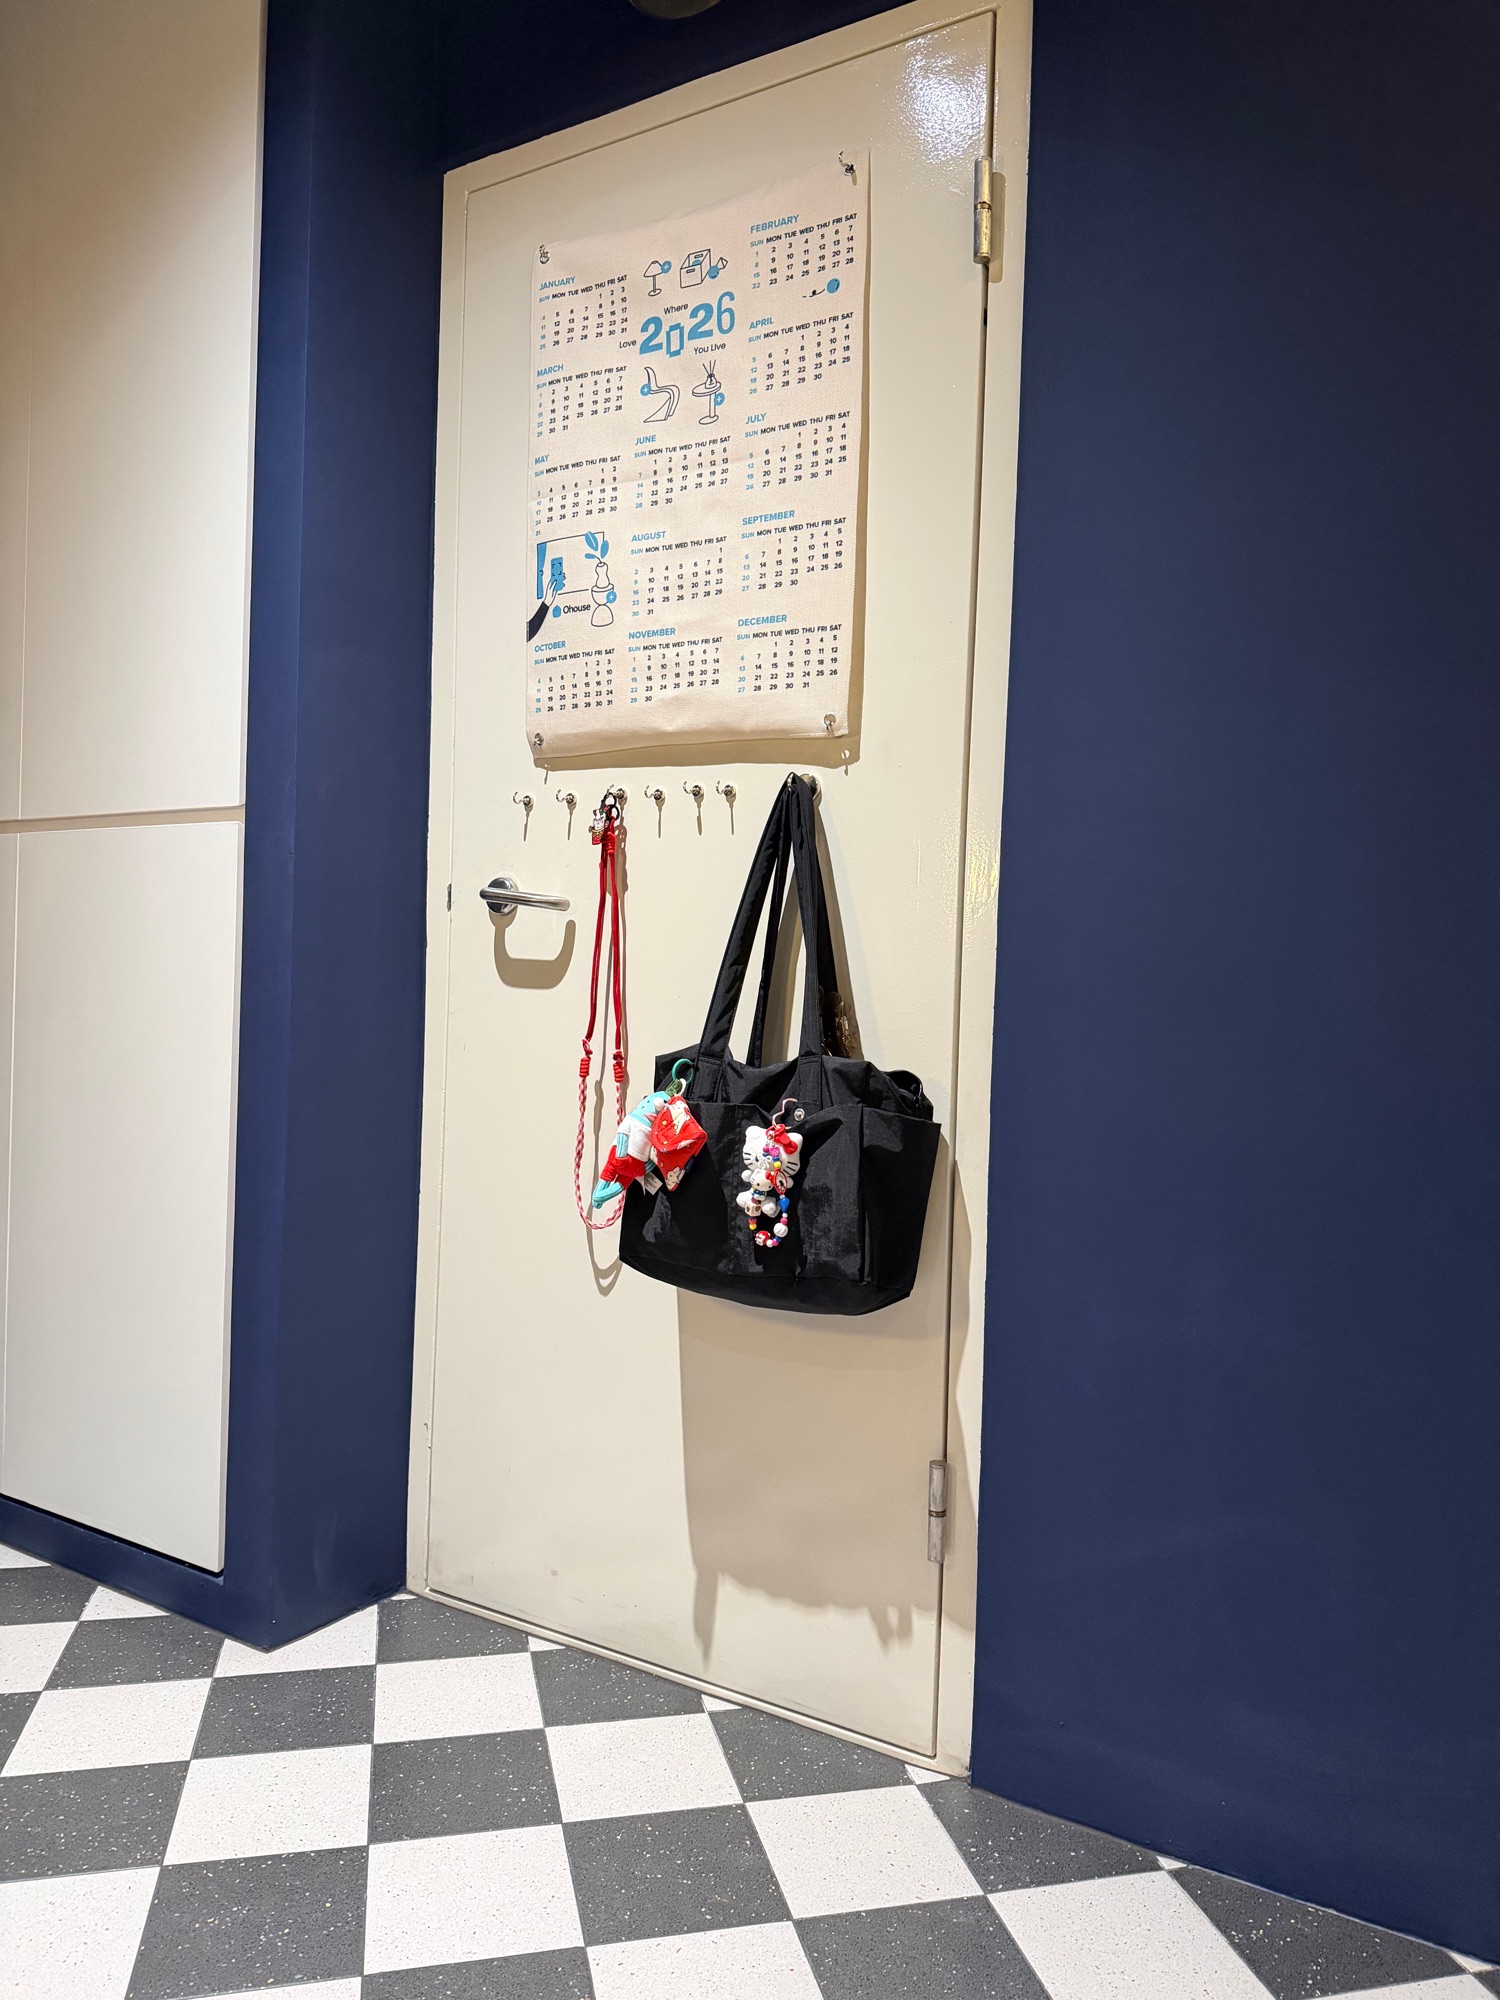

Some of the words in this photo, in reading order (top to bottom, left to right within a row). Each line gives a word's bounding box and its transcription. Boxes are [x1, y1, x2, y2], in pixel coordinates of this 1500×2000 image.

[750, 214, 799, 233] FEBRUARY
[766, 235, 782, 243] MON
[799, 227, 814, 235] WED
[817, 221, 830, 230] THU
[832, 217, 842, 225] FRI
[845, 213, 857, 221] SAT
[539, 276, 575, 290] JANUARY
[664, 303, 688, 315] Where
[749, 317, 774, 330] APRIL
[764, 331, 779, 339] MON
[796, 323, 810, 331] WED
[813, 319, 826, 327] THU
[829, 315, 839, 323] FRI
[841, 312, 853, 320] SAT
[619, 339, 637, 348] Love
[694, 346, 709, 355] You
[711, 342, 726, 352] Live
[537, 364, 563, 377] MARCH
[548, 378, 560, 386] MON
[746, 413, 766, 424] JULY
[761, 426, 775, 434] MON
[838, 411, 850, 419] SAT
[635, 435, 656, 445] JUNE
[535, 454, 549, 465] MAY
[742, 510, 795, 525] SEPTEMBER
[789, 524, 803, 532] WED
[631, 531, 666, 542] AUGUST
[563, 604, 591, 614] Ohouse
[738, 615, 787, 626] DECEMBER
[629, 628, 675, 639] NOVEMBER
[535, 641, 565, 652] OCTOBER
